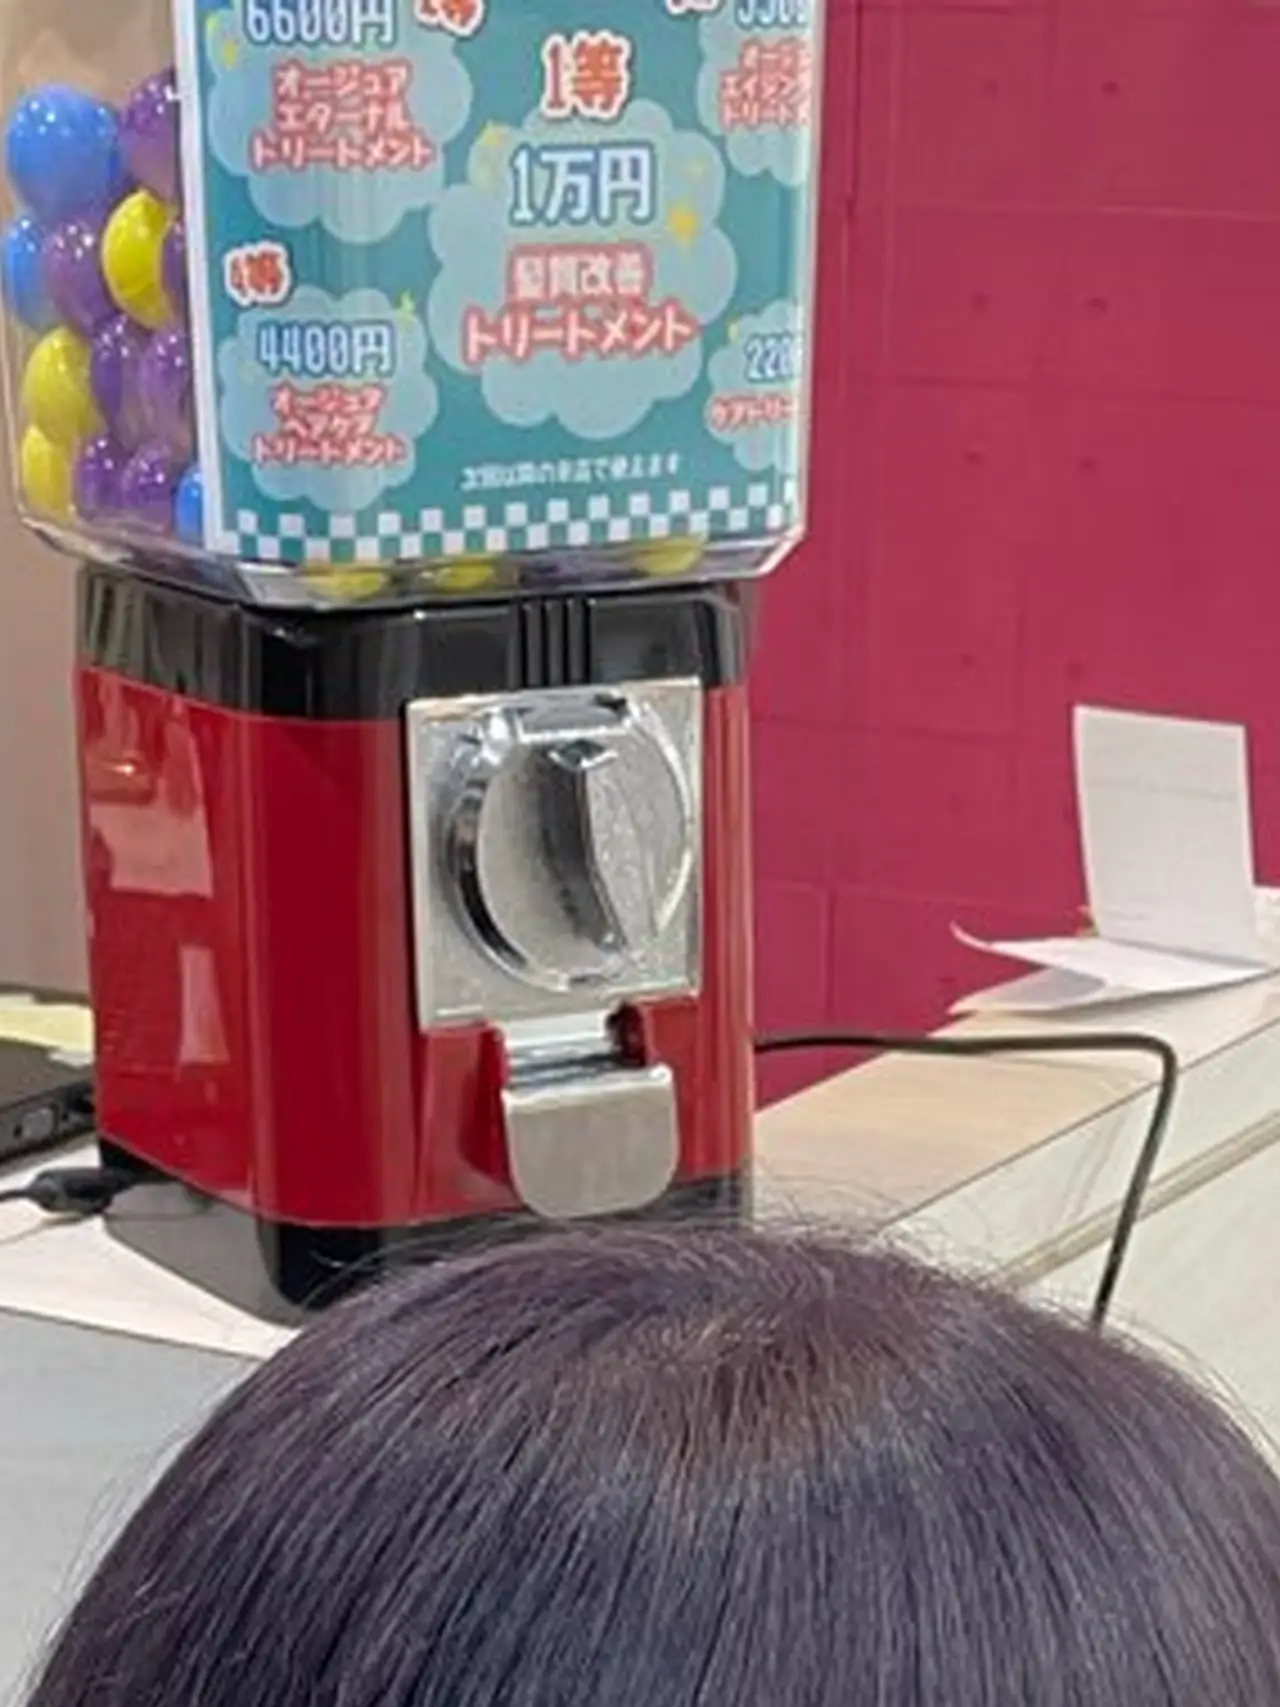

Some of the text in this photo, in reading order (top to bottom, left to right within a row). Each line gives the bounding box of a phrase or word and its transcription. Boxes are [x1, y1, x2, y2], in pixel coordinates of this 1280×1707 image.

[246, 0, 395, 45] 6600円
[540, 33, 628, 116] 1等
[252, 132, 434, 169] トリートメント
[512, 145, 654, 222] 1万円
[259, 322, 393, 374] 4400円
[466, 302, 693, 364] トリートメント
